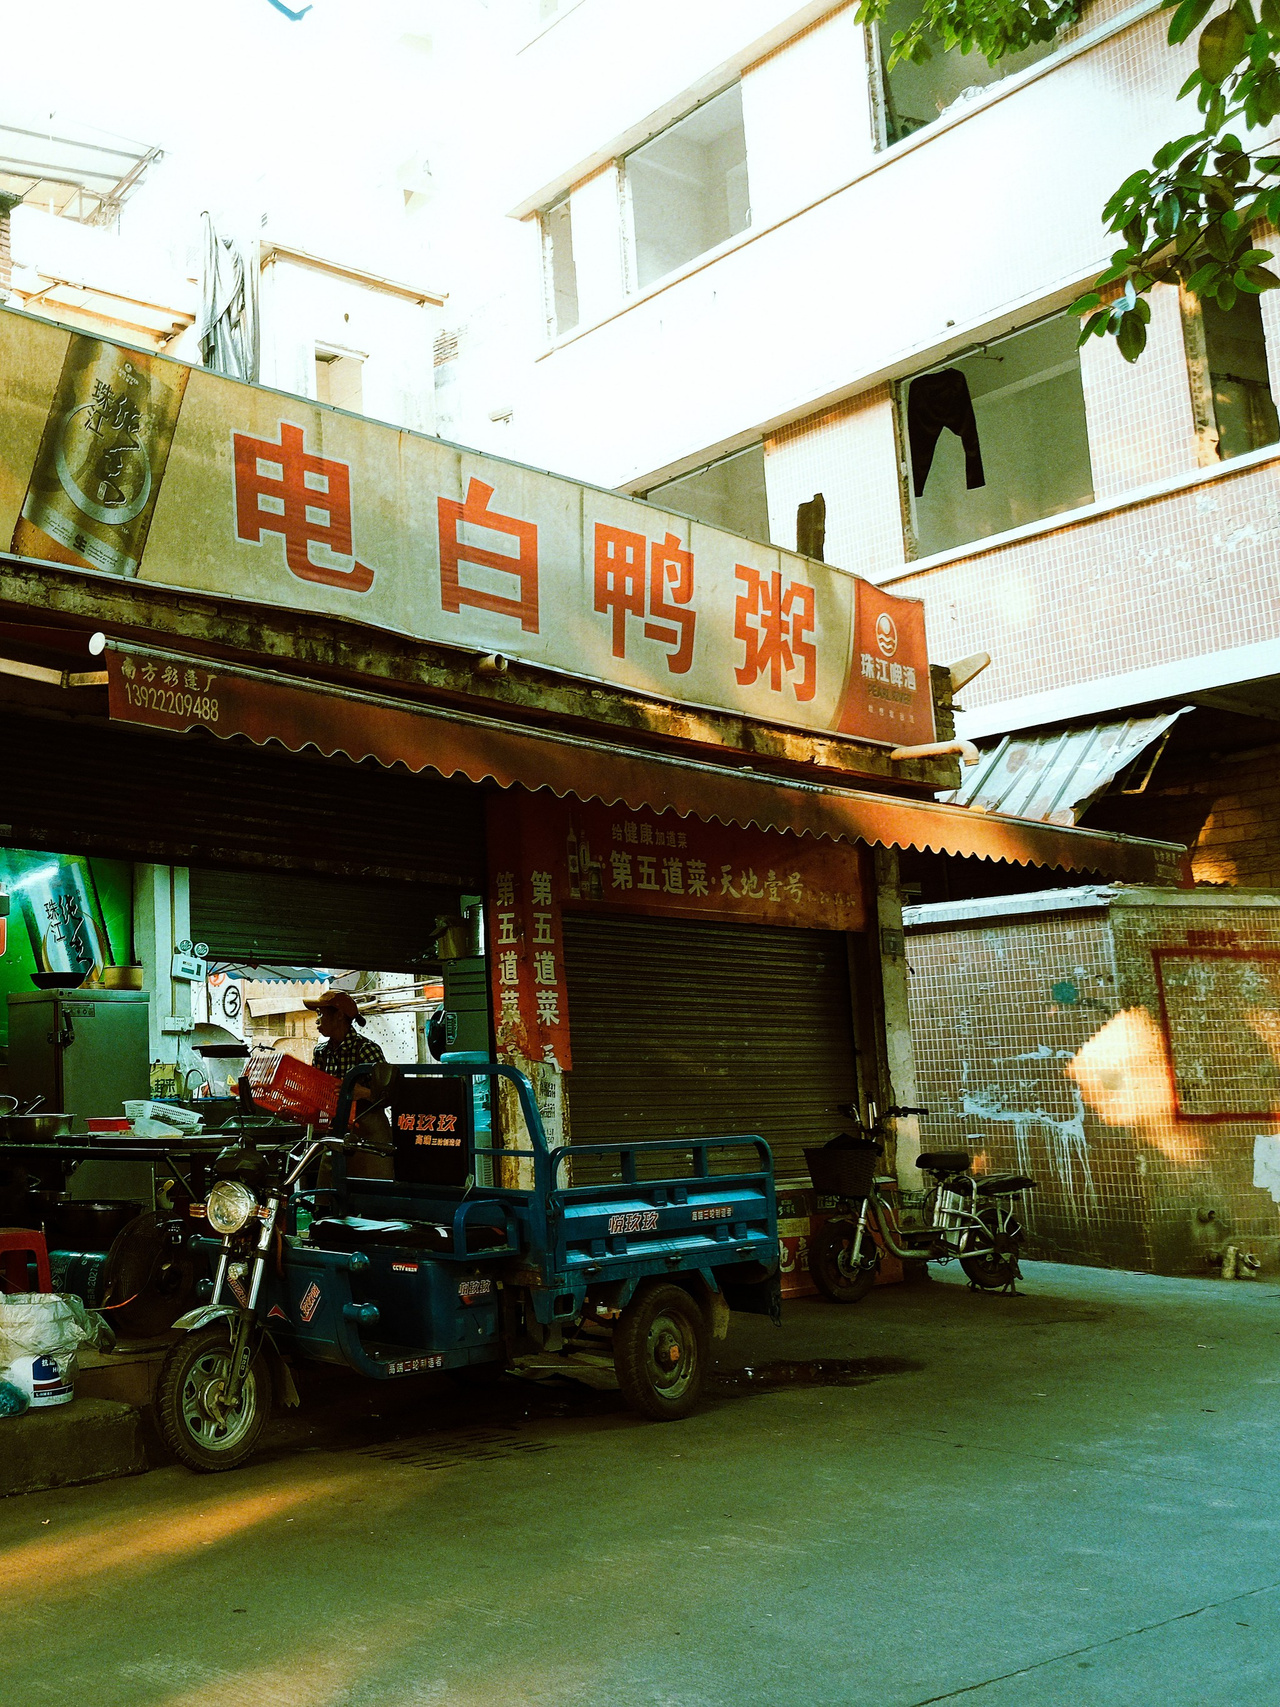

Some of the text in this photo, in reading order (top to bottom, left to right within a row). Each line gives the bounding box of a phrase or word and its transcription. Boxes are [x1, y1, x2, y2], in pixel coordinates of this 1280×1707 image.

[232, 421, 817, 702] 电白鸭粥
[860, 653, 917, 691] 珠江啤酒
[124, 682, 219, 722] 13922209488
[612, 820, 688, 849] 给健康加道菜
[43, 898, 66, 942] 珠江
[495, 871, 522, 1026] 第五道菜
[530, 870, 561, 1027] 第五道菜
[398, 1113, 458, 1132] 悦玖玖
[608, 1211, 659, 1235] 悦玖玖
